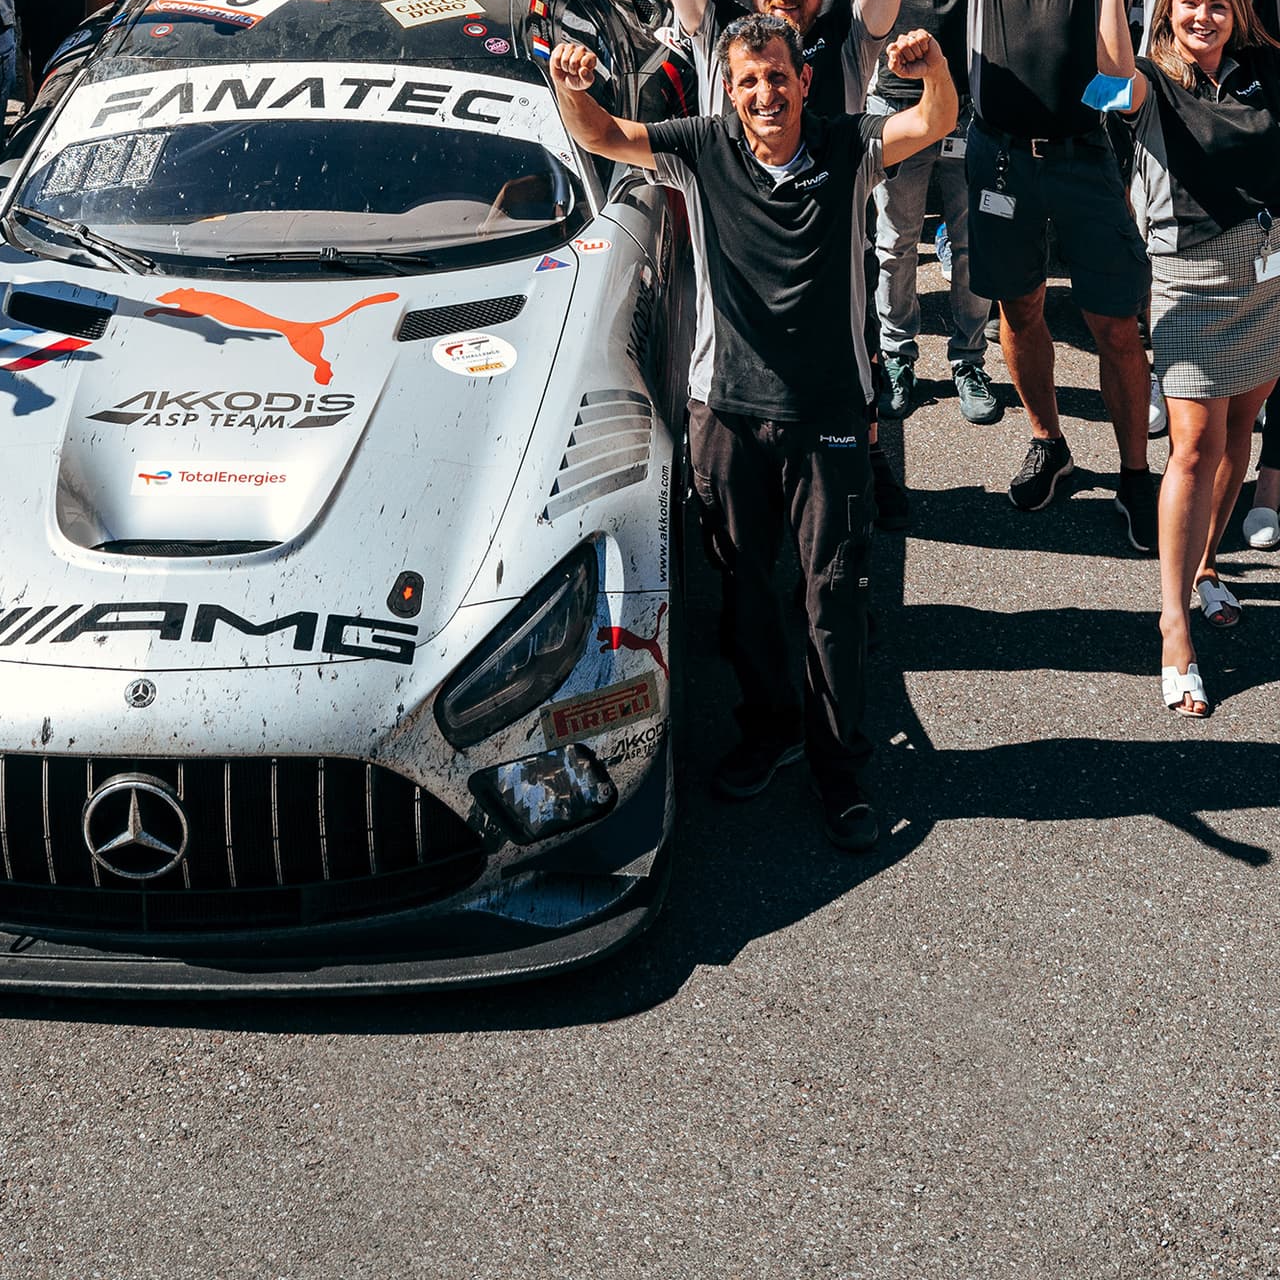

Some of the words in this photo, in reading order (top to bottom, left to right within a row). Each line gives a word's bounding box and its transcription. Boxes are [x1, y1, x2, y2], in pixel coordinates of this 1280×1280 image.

[160, 1, 258, 25] CROWDSTRIKE
[794, 171, 830, 189] HWA
[143, 413, 199, 426] ASP
[210, 413, 286, 429] TEAM
[819, 434, 856, 443] HWA
[178, 471, 287, 486] TotalEnergies
[659, 465, 670, 583] www.akkodis.com
[552, 682, 652, 738] PIRELLI
